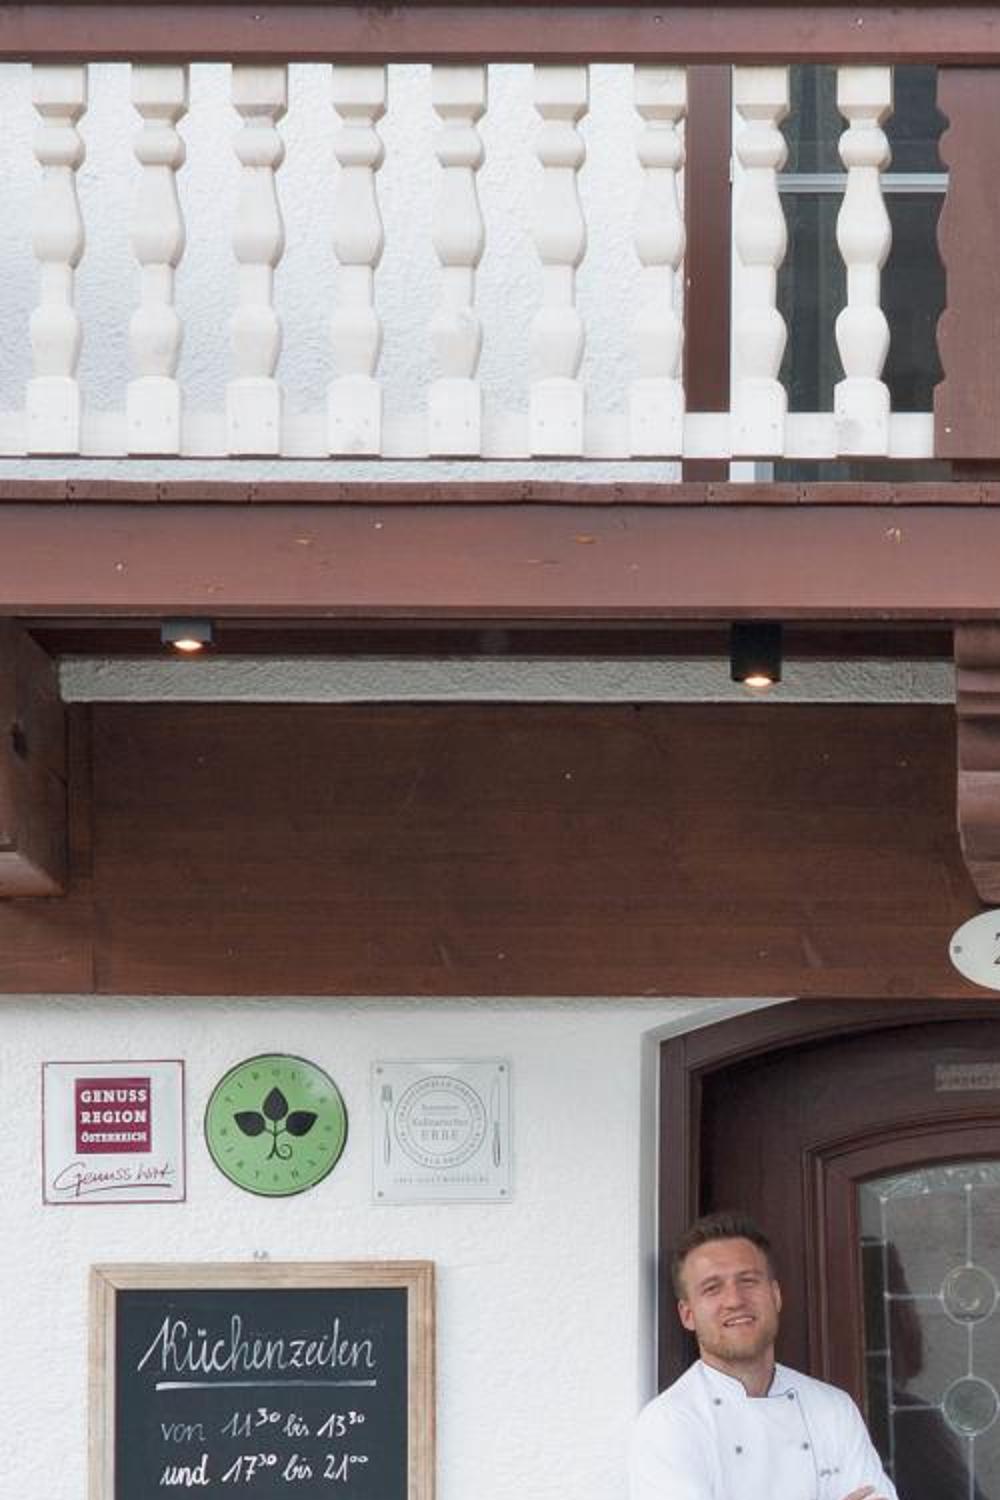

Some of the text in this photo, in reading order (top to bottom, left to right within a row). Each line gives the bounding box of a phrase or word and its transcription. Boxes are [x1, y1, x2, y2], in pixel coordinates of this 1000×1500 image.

[80, 1089, 147, 1103] GENUSS
[80, 1109, 147, 1124] REGION
[80, 1130, 147, 1143] ÖSTERREICH
[137, 1314, 377, 1373] Küchenzeiten
[160, 1421, 206, 1442] von
[283, 1413, 310, 1437] bis
[159, 1452, 208, 1487] und
[282, 1454, 312, 1482] bis
